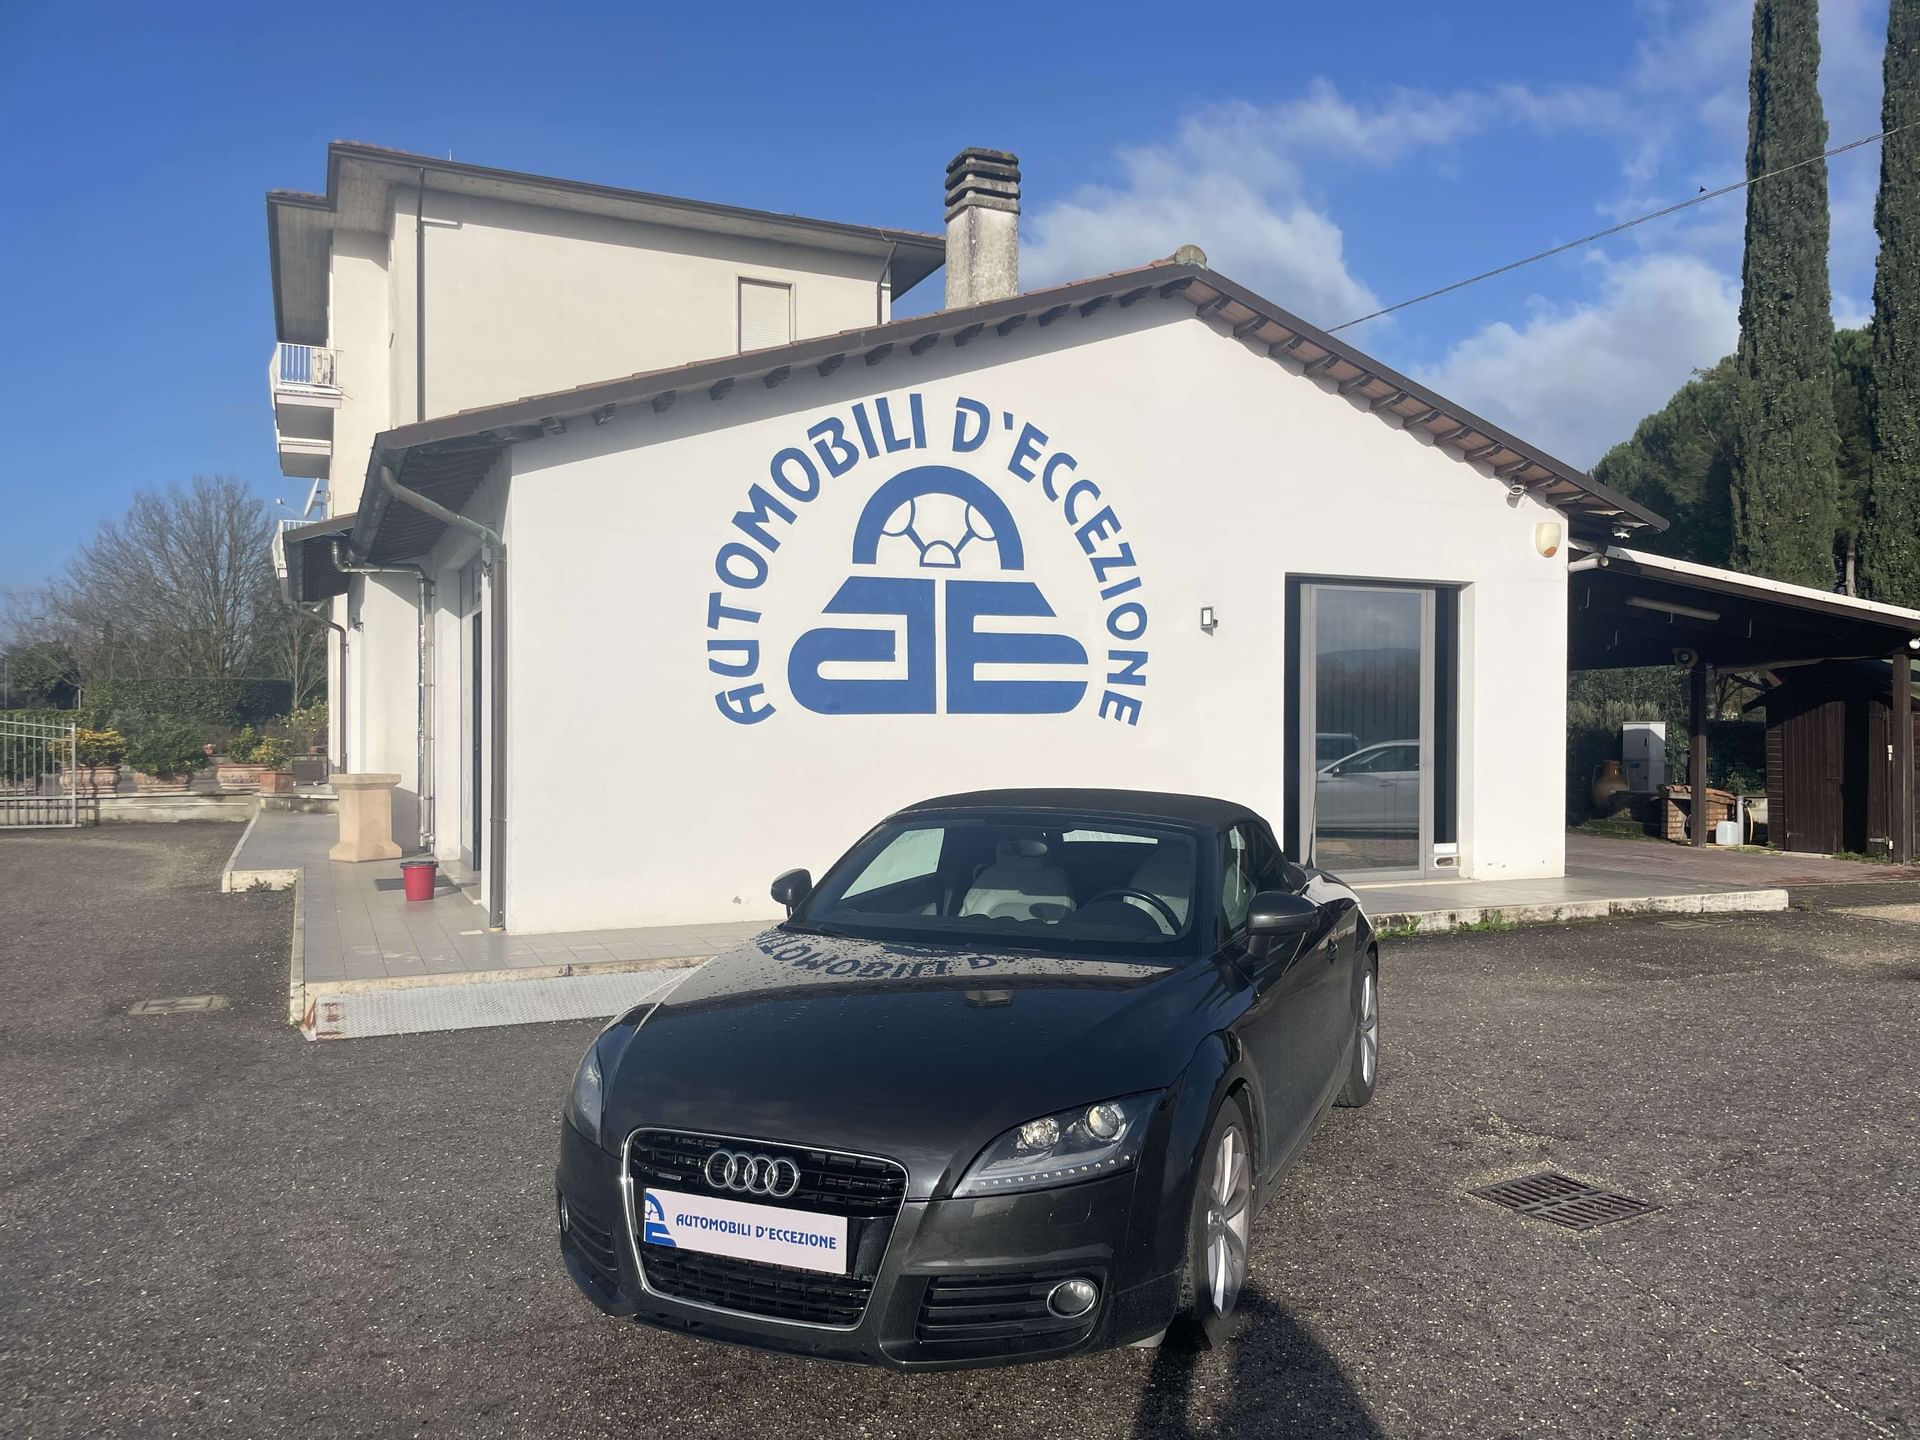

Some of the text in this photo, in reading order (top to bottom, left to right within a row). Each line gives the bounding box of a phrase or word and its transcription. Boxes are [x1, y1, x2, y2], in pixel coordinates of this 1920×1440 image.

[707, 394, 1148, 726] AUTOMOBILI D'ECCEZIONE
[676, 1214, 836, 1249] AUTOMOBILI D'ECCEZIONE
